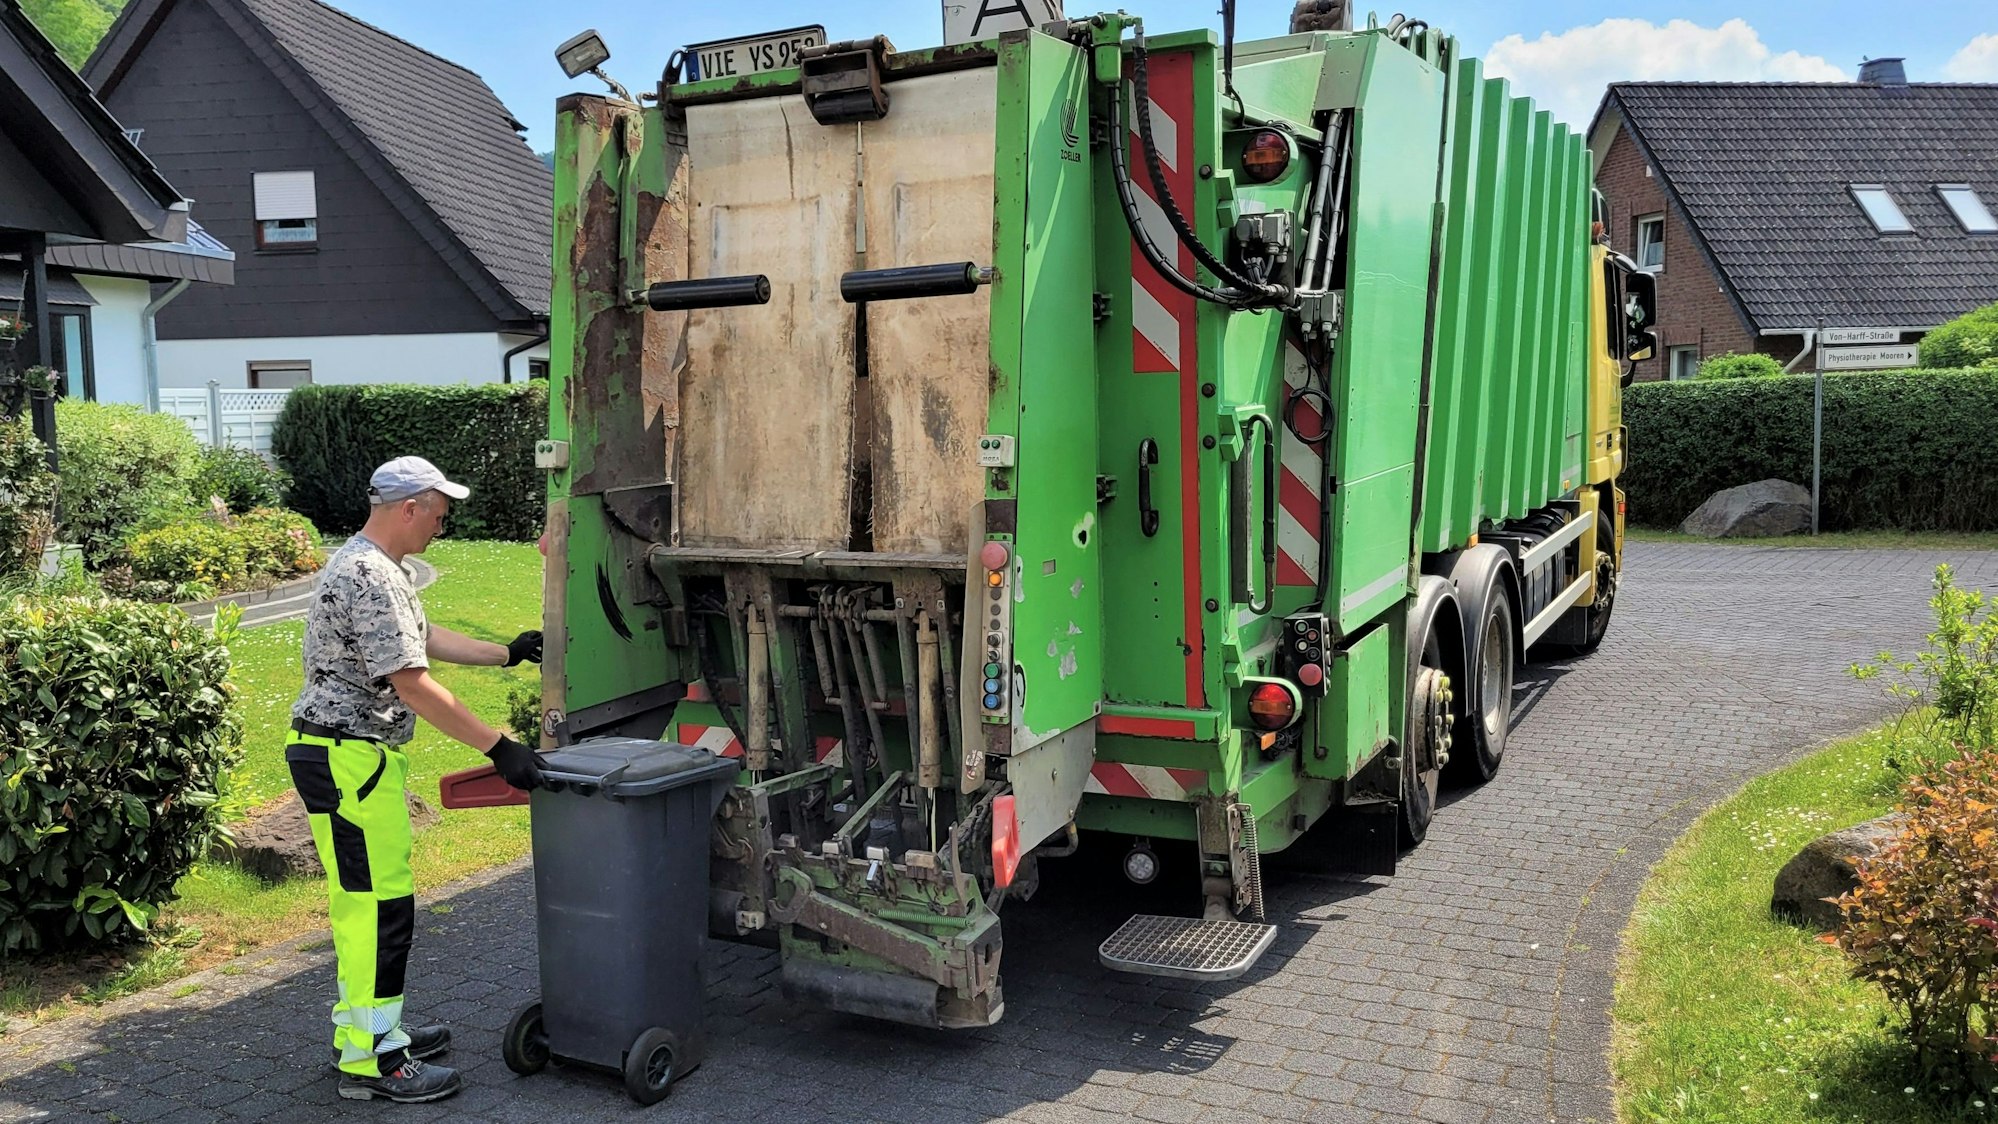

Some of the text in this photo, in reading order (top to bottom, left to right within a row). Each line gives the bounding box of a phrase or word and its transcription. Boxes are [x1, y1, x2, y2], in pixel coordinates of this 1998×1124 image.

[701, 50, 736, 78] VIE
[749, 44, 774, 71] YS
[1061, 149, 1081, 163] ZOELLER
[1829, 332, 1893, 341] Von-Harff-Straße
[1828, 352, 1904, 363] Physiotherapie Mooren
